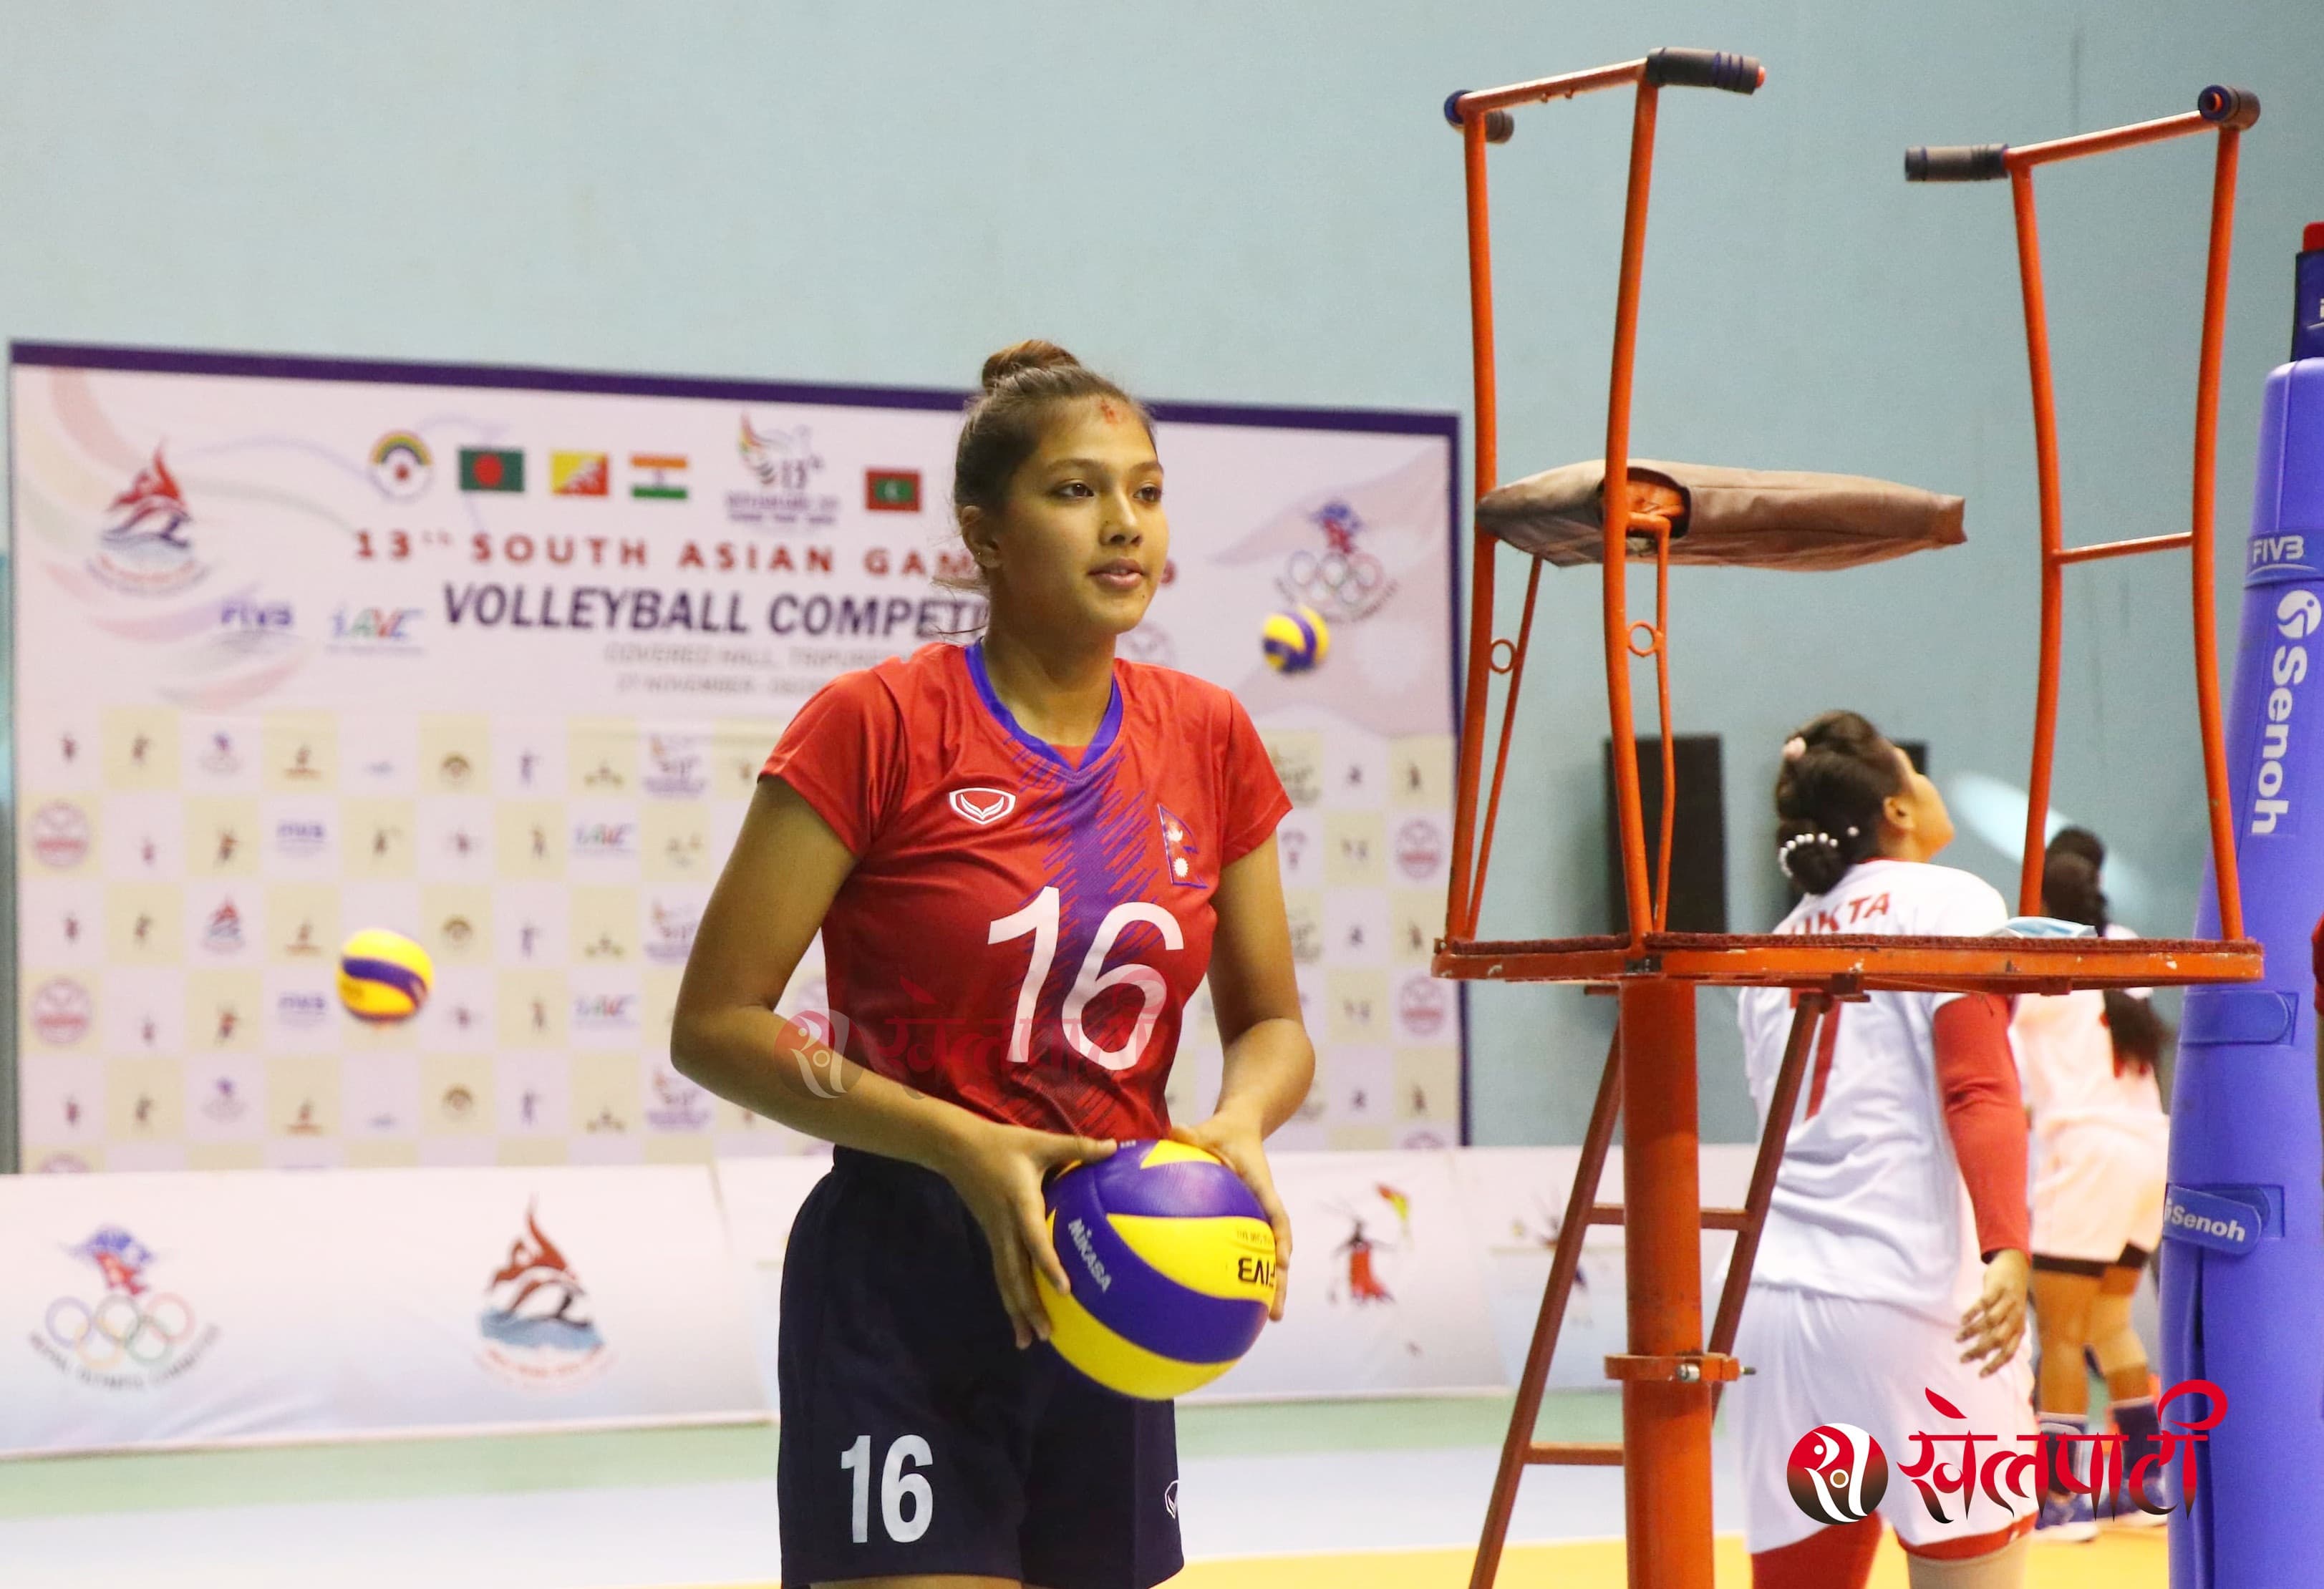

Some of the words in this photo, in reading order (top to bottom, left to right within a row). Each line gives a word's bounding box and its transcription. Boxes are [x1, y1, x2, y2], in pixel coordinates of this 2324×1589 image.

[471, 534, 647, 568] SOUTH
[677, 541, 834, 573] ASIAN
[863, 547, 972, 577] GAM
[2253, 535, 2304, 564] FIVB
[442, 583, 747, 633] VOLLEYBALL
[768, 593, 988, 639] COMPETI
[2251, 646, 2308, 834] Senoh
[1791, 892, 1891, 934] UKTA
[987, 885, 1184, 1071] 16
[2171, 1205, 2246, 1242] Senoh
[841, 1434, 934, 1543] 16
